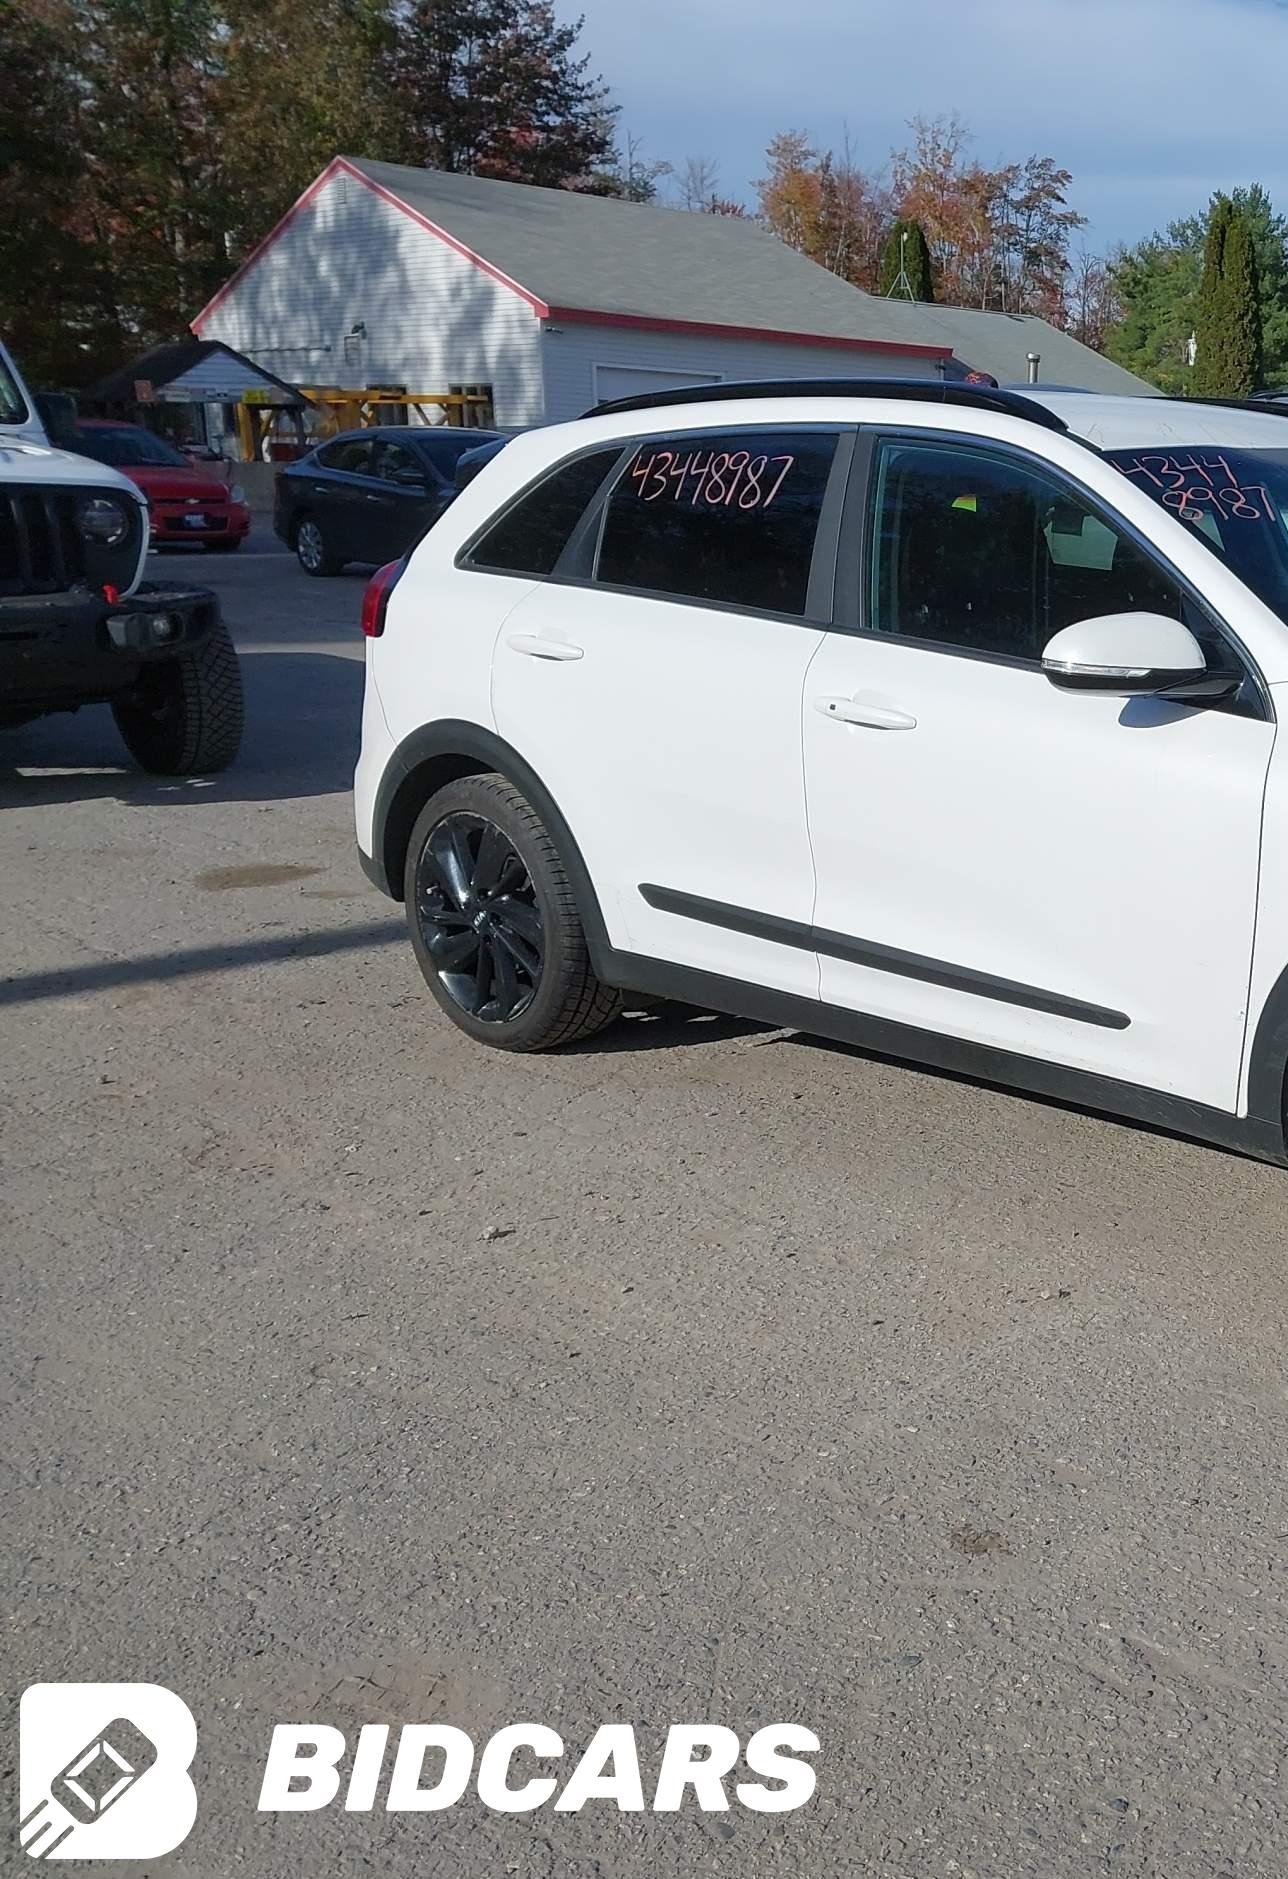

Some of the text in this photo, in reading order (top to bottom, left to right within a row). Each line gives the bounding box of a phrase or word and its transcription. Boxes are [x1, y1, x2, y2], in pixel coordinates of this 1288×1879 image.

[632, 450, 794, 509] 43448987
[1110, 454, 1239, 489] 4344
[1161, 486, 1277, 522] 8987
